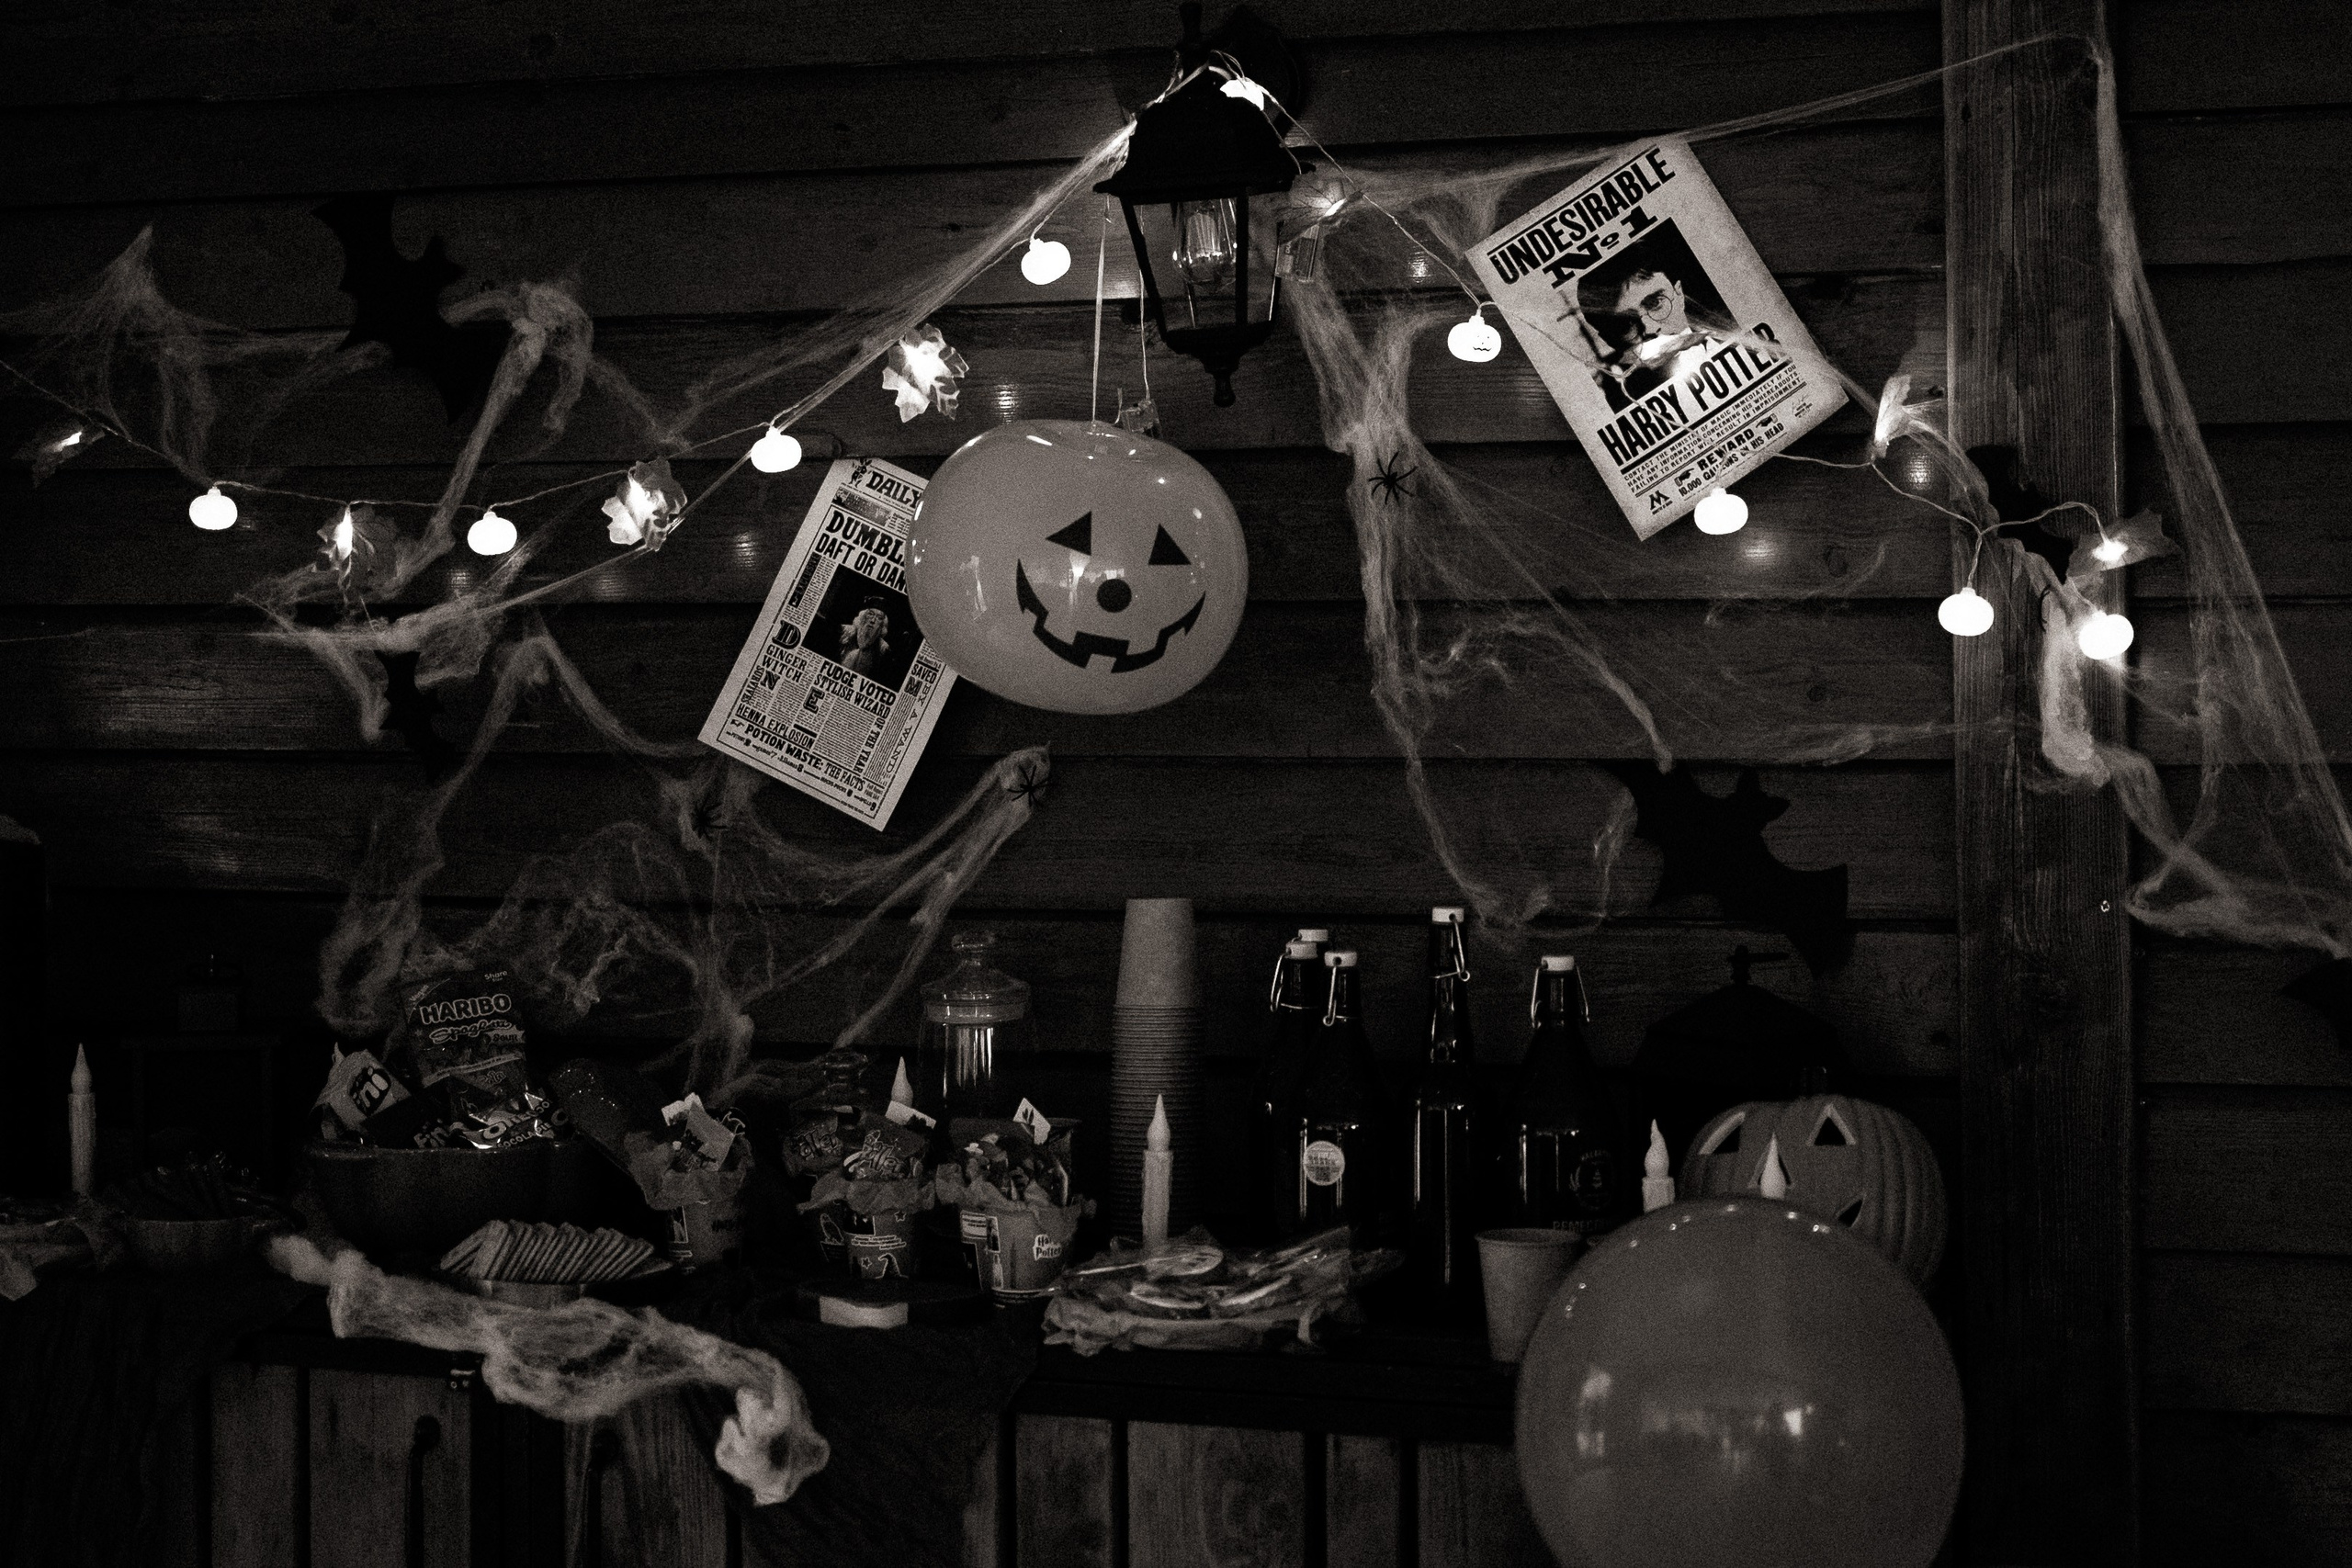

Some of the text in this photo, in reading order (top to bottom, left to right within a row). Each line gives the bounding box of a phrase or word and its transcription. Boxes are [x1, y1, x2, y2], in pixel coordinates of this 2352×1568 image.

[1489, 148, 1676, 284] UNDESIRABLE
[1596, 384, 1689, 467] HARRY
[1688, 322, 1783, 412] POTTER
[1623, 459, 1653, 480] CONTACT
[1655, 451, 1668, 461] THE
[1700, 423, 1707, 432] OF
[1710, 409, 1731, 425] MAGIC
[1732, 378, 1774, 411] IMMEDIATELY
[1783, 364, 1796, 375] YOU
[1627, 473, 1644, 487] HAVE
[1646, 464, 1658, 475] ANY
[1659, 437, 1702, 466] INFORMATION
[1702, 411, 1740, 438] CONCERNING
[1741, 402, 1752, 412] HIS
[1749, 435, 1764, 449] HIS
[1764, 423, 1783, 439] HEAD
[1630, 472, 1658, 492] FAILING
[1659, 466, 1669, 474] TO
[1670, 448, 1695, 467] REPORT
[1697, 437, 1714, 449] WIL
[1715, 418, 1740, 437] RESULT
[1696, 428, 1754, 470] REWARD
[865, 470, 923, 509] DAILY
[814, 532, 855, 564] DAFT
[854, 551, 877, 576] OR
[825, 510, 912, 567] DUMBL
[762, 654, 803, 682] WITCH
[765, 643, 807, 671] GINGER
[910, 663, 937, 684] SAVED
[741, 664, 764, 704] SURVIVES
[813, 673, 854, 702] STYLISH
[854, 691, 890, 719] WIZARD
[819, 660, 896, 705] FUDGE VOTED
[736, 703, 815, 749] HENNA EXPLOSION
[853, 716, 885, 773] OF THE YEAR
[886, 725, 912, 773] WAND
[744, 723, 786, 750] POTION
[785, 743, 823, 770] WASTE:
[823, 761, 842, 779] THE
[839, 770, 865, 791] FACTS
[420, 993, 512, 1026] HARIBO
